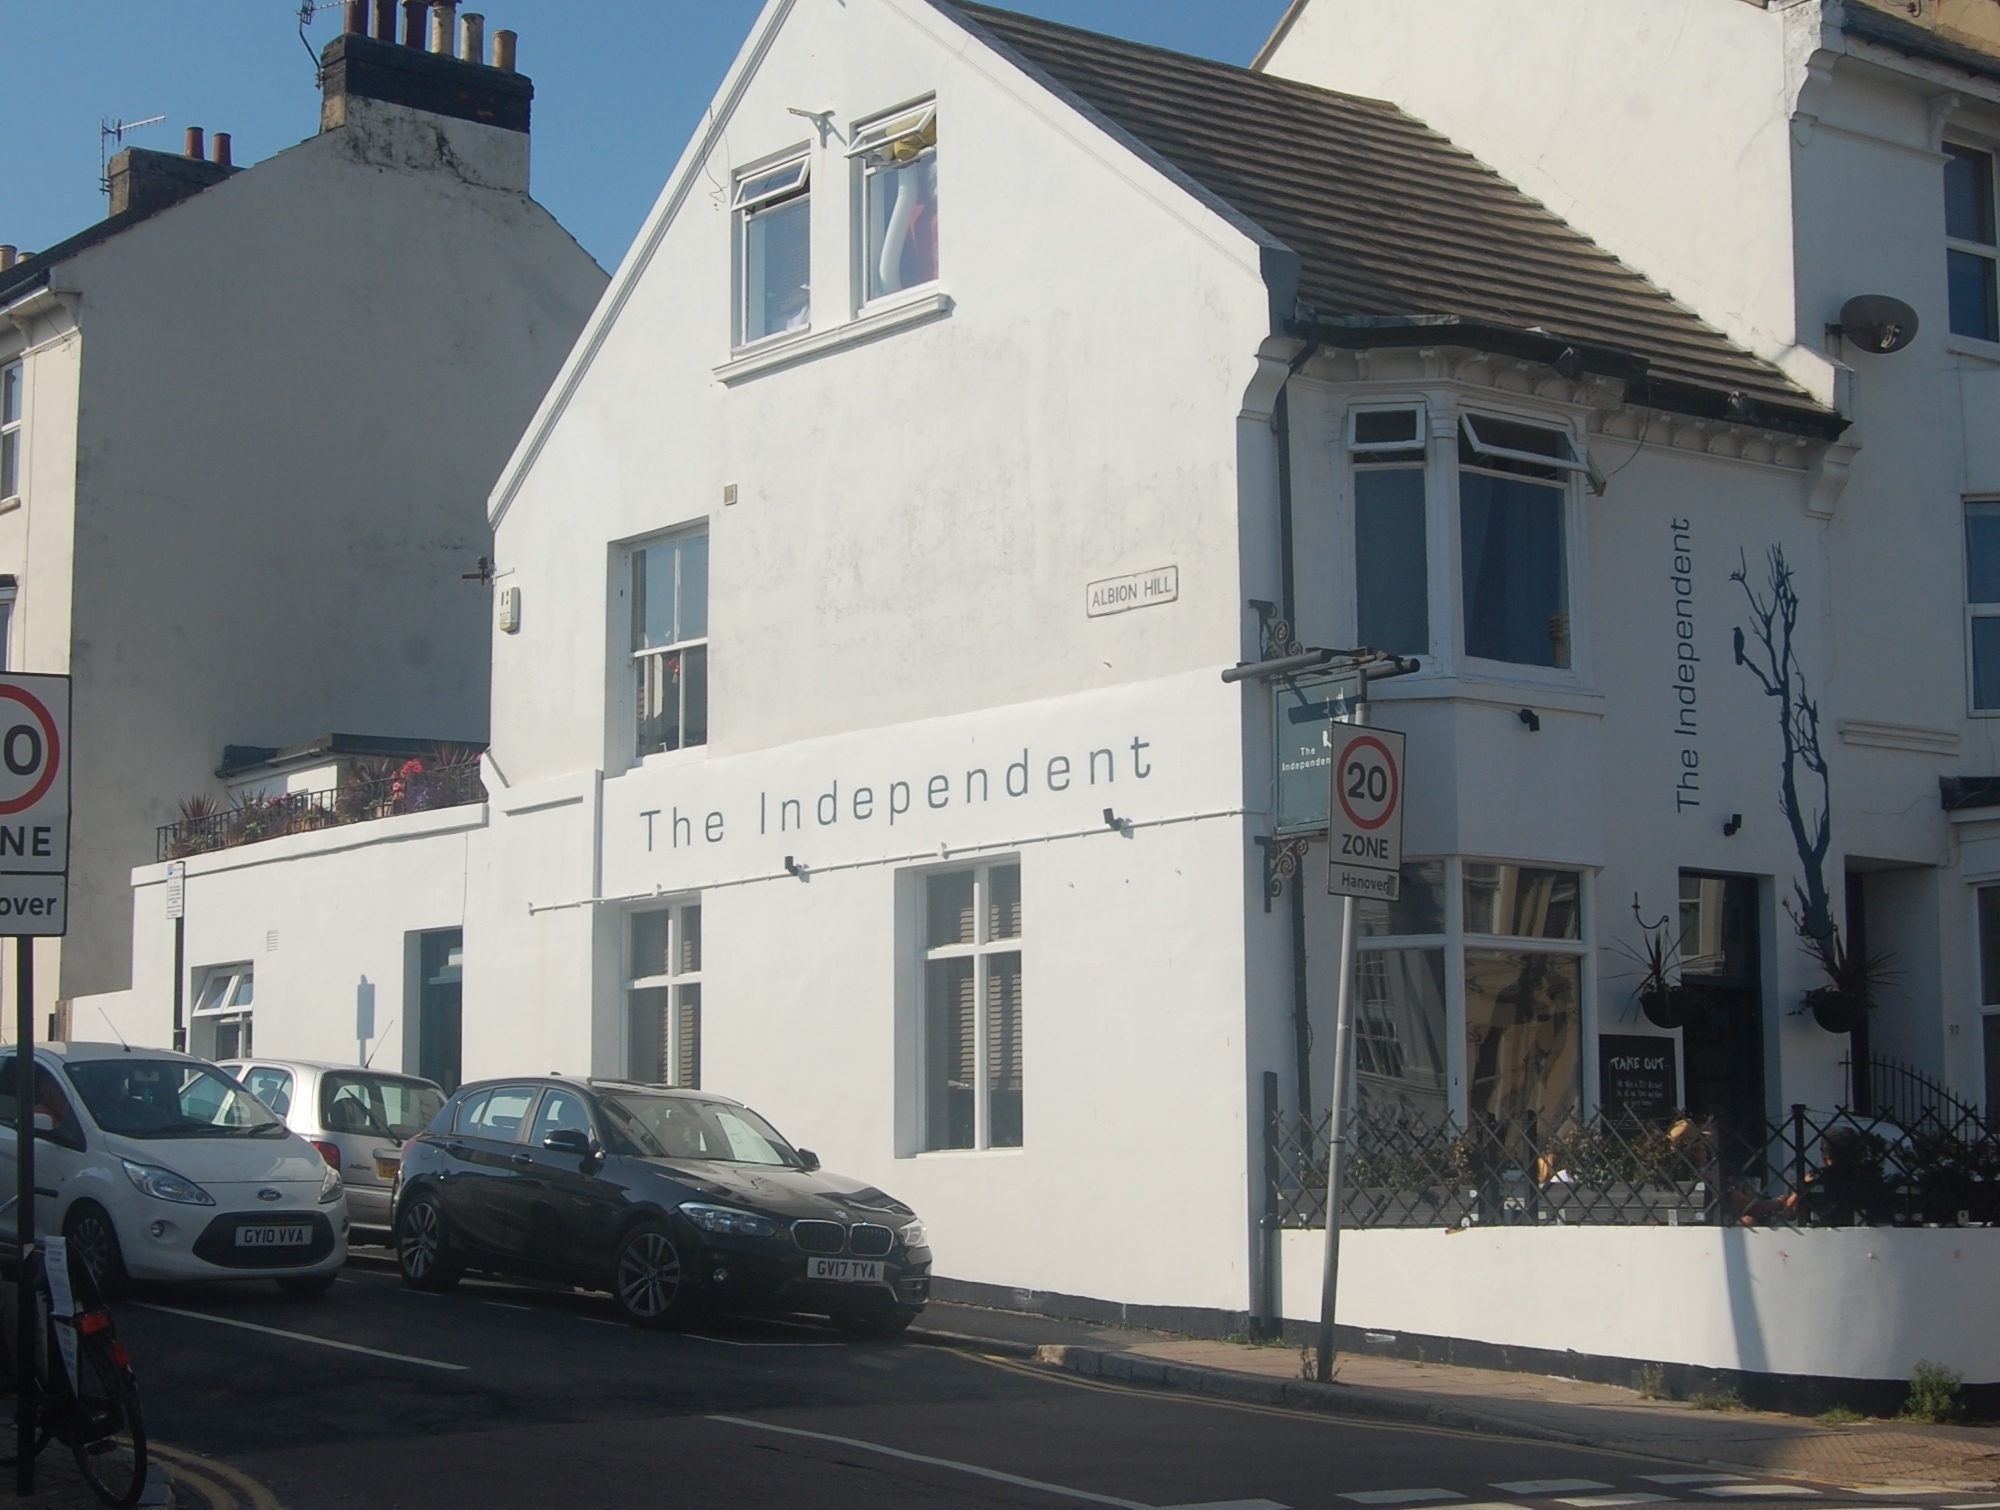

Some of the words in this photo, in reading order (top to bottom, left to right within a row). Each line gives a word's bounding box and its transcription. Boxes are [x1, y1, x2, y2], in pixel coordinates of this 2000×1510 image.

[1092, 583, 1137, 607] ALBION
[1144, 576, 1172, 597] HILL
[1670, 518, 1700, 736] Independent
[3, 724, 42, 776] 0
[1300, 746, 1316, 756] The
[1282, 757, 1331, 771] Independen
[640, 807, 724, 852] The
[760, 736, 1151, 835] Independent
[1347, 762, 1388, 802] 20
[1676, 749, 1700, 813] The
[0, 826, 52, 856] NE
[1342, 833, 1388, 859] ZONE
[1341, 872, 1388, 892] Hanover
[0, 896, 57, 916] over
[1610, 1055, 1640, 1071] TAKE
[1643, 1057, 1664, 1070] OUT
[244, 1229, 275, 1243] GY10
[280, 1229, 303, 1242] VVA
[817, 1261, 848, 1277] GV17
[852, 1262, 876, 1279] TYA
